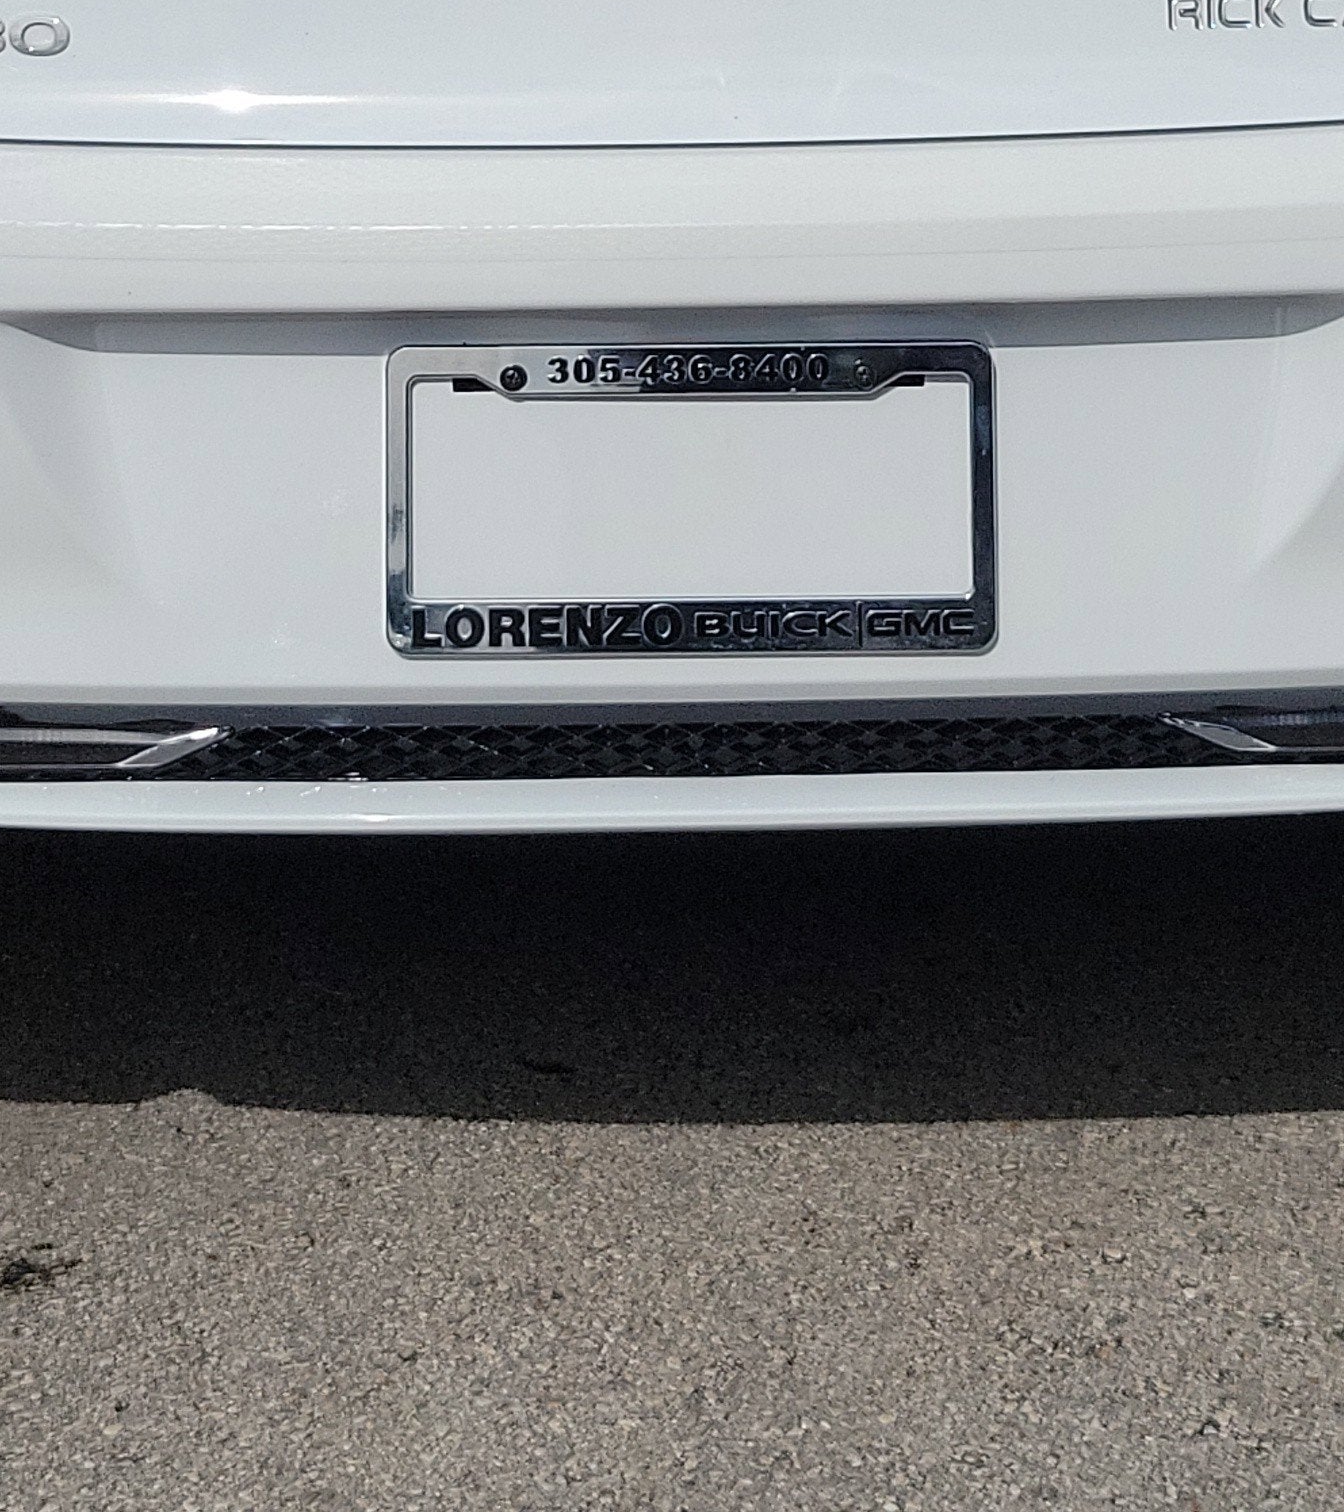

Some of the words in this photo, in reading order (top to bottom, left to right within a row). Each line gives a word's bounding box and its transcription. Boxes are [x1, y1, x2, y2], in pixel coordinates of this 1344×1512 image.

[547, 353, 829, 384] 305-436-8400
[411, 603, 684, 648] LORENZO
[694, 609, 854, 638] BUICK
[865, 609, 975, 637] GMC
